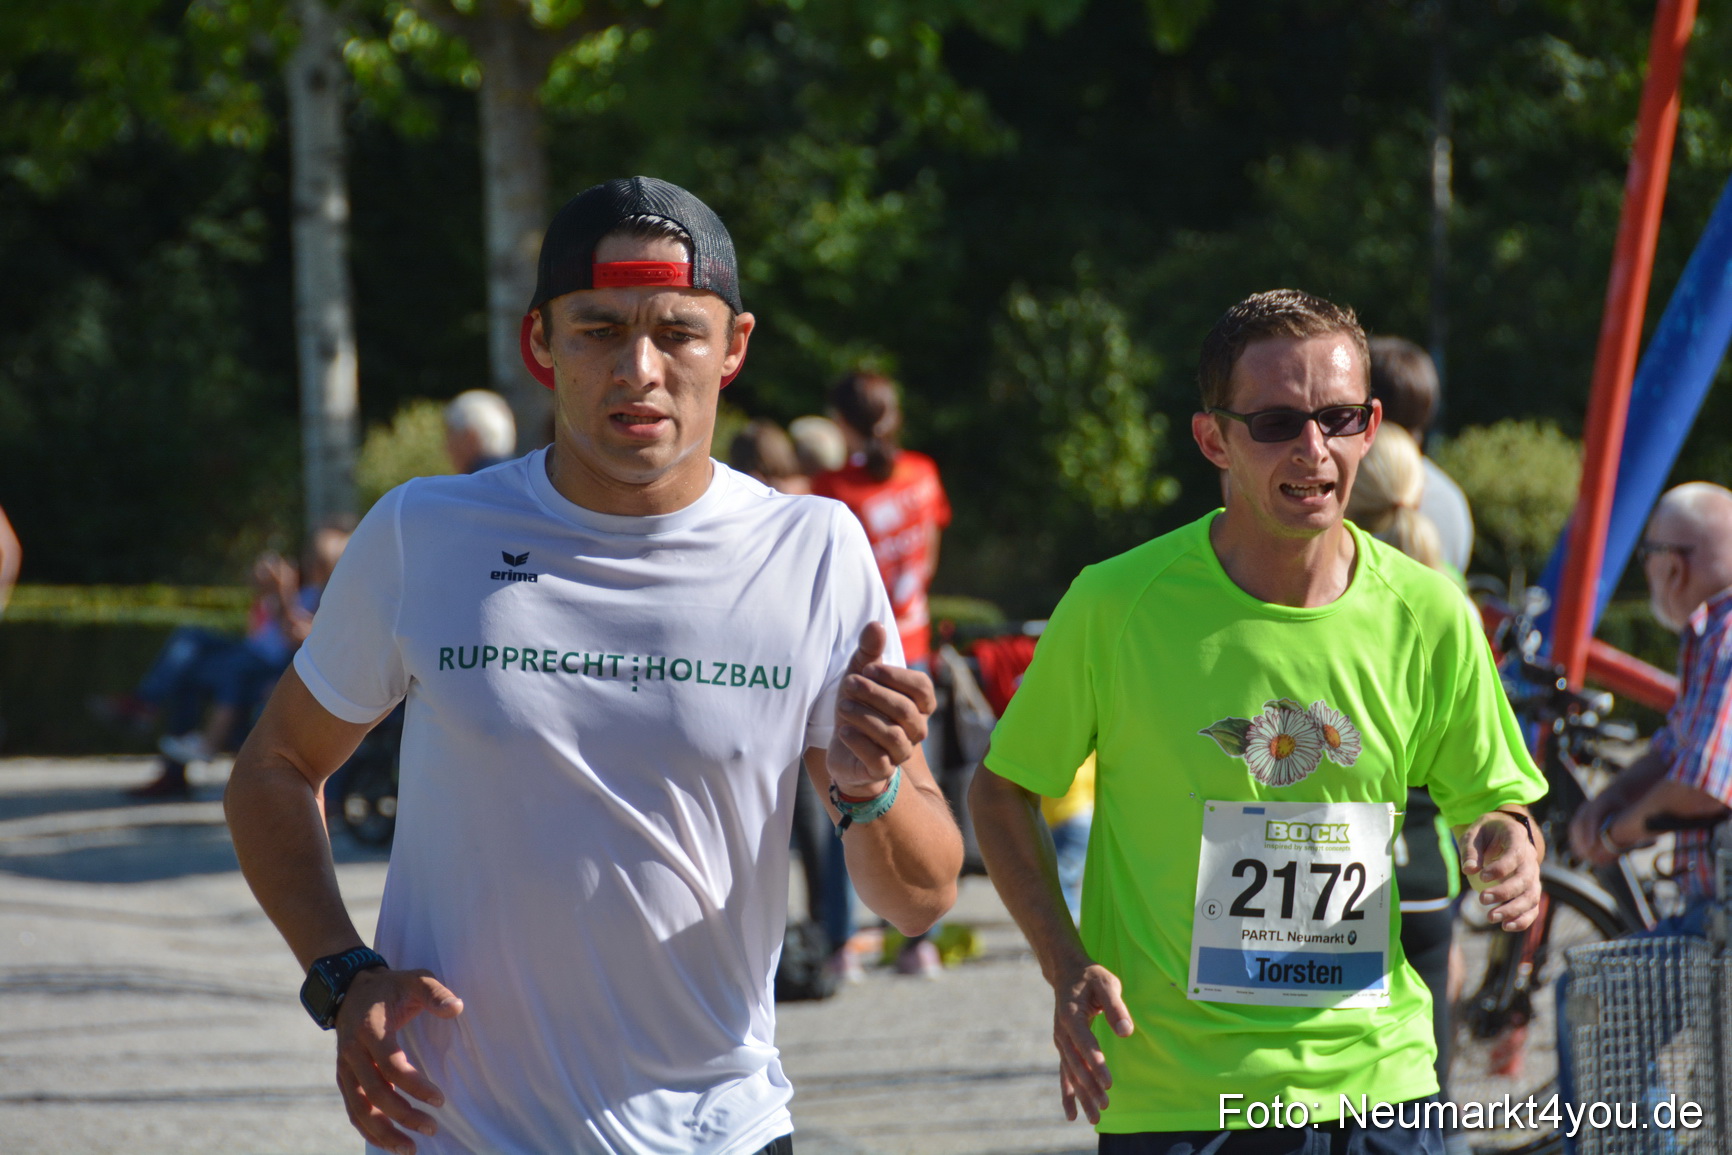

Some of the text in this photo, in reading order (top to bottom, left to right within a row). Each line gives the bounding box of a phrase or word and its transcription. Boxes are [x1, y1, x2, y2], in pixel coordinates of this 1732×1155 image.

[490, 568, 538, 583] erima
[439, 645, 793, 690] RUPPRECHT HOLZBAU
[1265, 820, 1350, 844] BOCK
[1264, 842, 1293, 851] inspired
[1294, 844, 1303, 852] by
[1229, 858, 1366, 921] 2172
[1208, 903, 1216, 915] C
[1242, 930, 1345, 944] PARTL Neumarkt
[1256, 957, 1343, 985] Torsten
